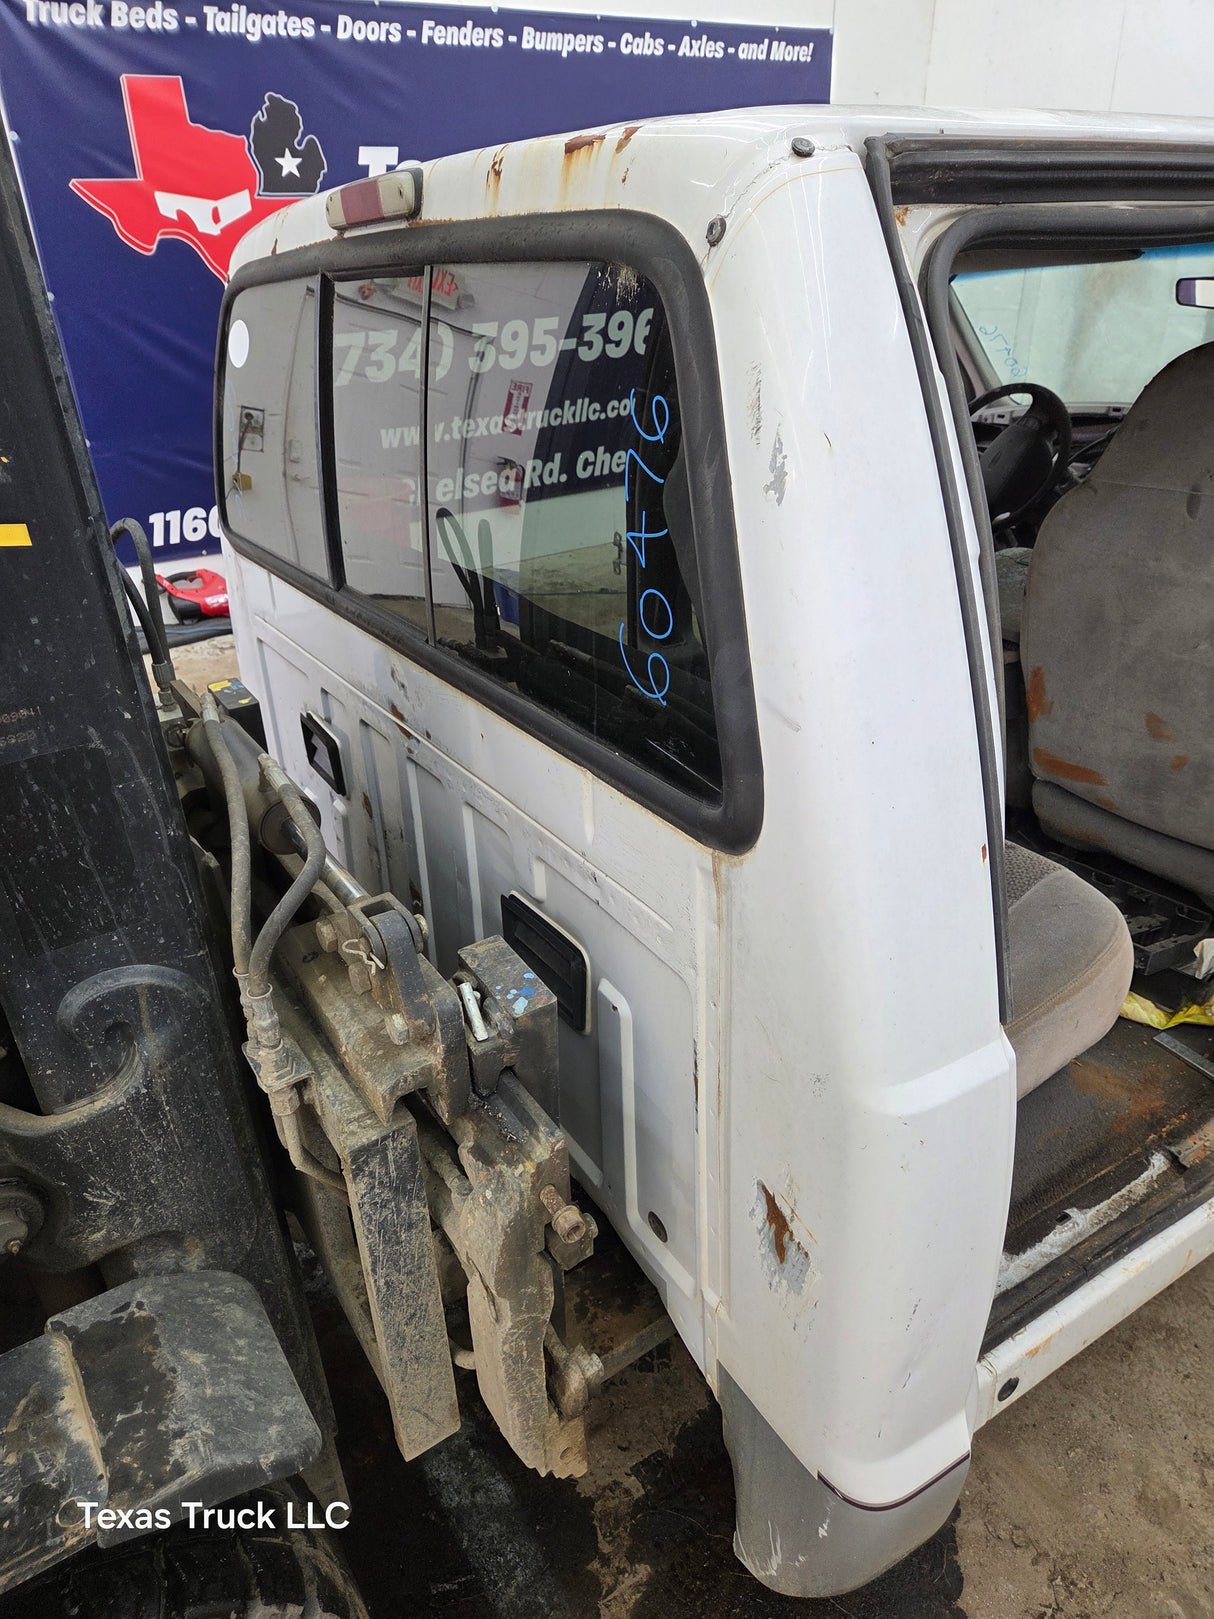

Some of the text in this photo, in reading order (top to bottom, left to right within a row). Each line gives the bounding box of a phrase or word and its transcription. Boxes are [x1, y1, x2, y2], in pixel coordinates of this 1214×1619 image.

[23, 0, 104, 26] Truck
[111, 0, 178, 30] Beds
[203, 3, 315, 41] Tailgates
[337, 14, 401, 42] Doors
[421, 20, 504, 47] Fenders
[521, 26, 604, 58] Bumpers
[620, 32, 664, 55] Cabs
[678, 35, 725, 58] Axles
[738, 38, 769, 60] and
[770, 40, 814, 62] More!
[523, 453, 567, 489] Rd.
[619, 388, 673, 706] 60476
